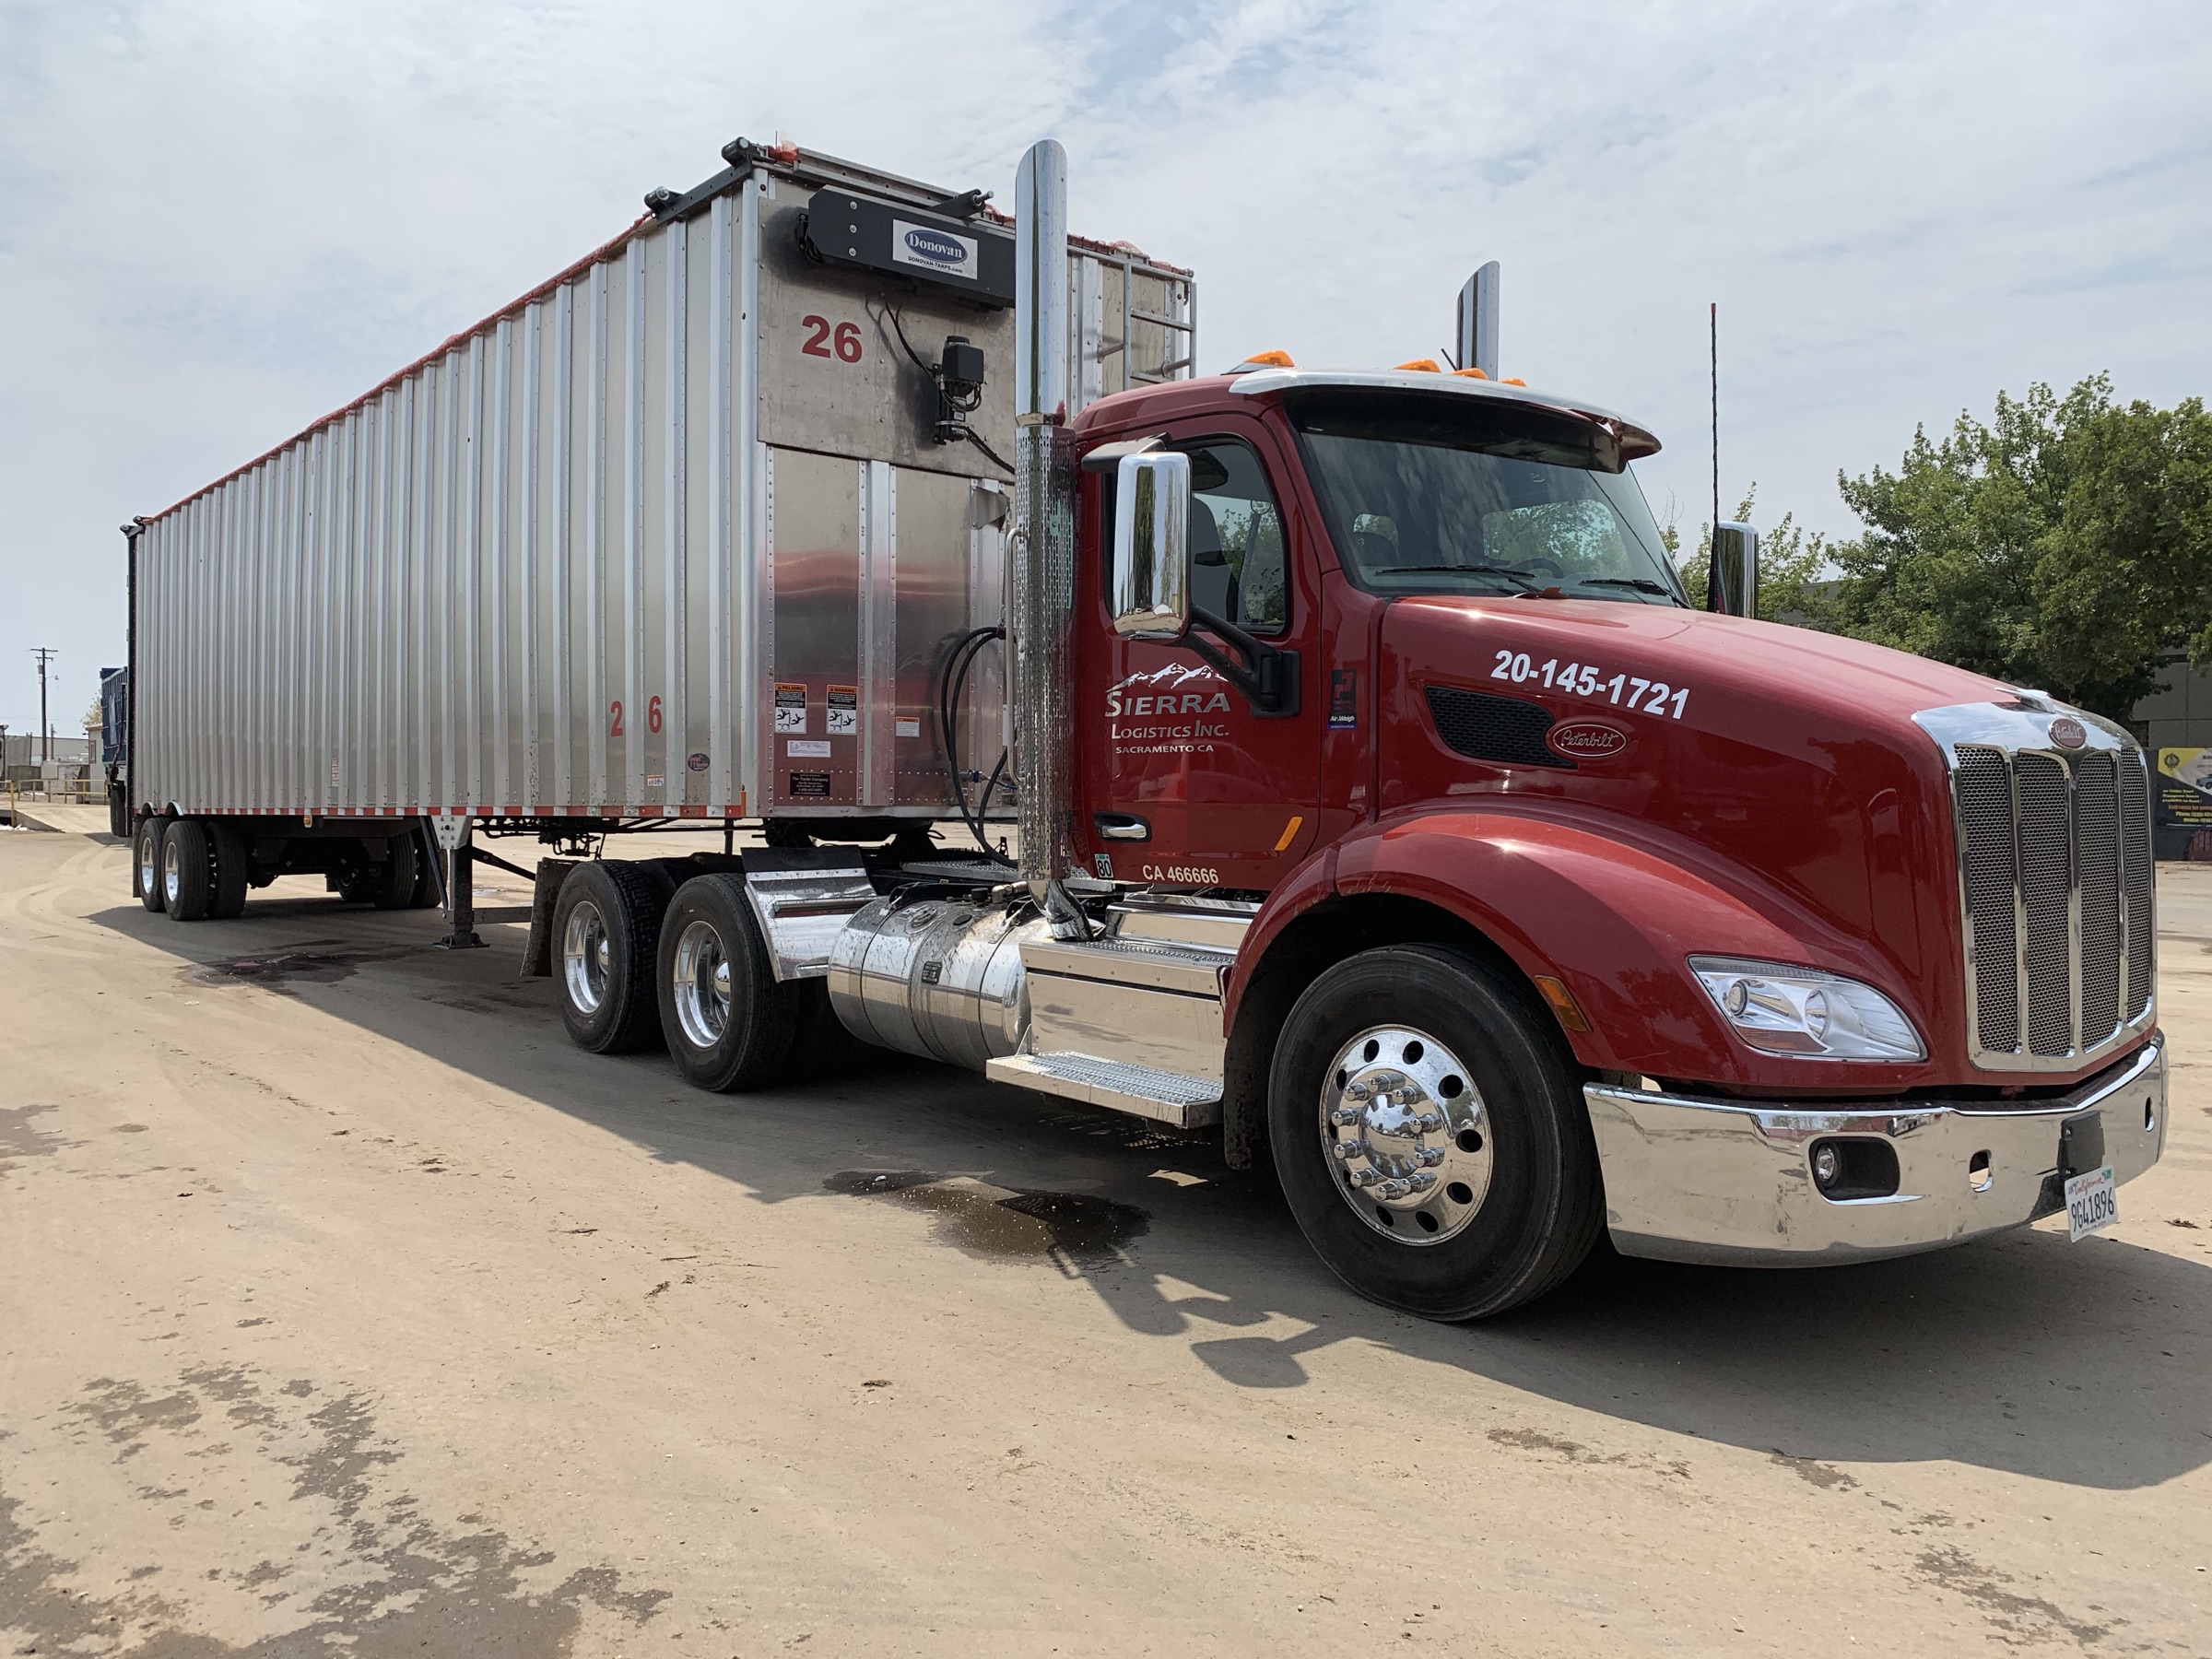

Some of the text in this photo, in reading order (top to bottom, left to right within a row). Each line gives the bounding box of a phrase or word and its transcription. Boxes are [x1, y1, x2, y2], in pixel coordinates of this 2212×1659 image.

[909, 233, 963, 258] Donovan
[908, 255, 963, 274] DONOVAN-TARPS.com
[801, 314, 863, 363] 26
[1490, 650, 1690, 720] 20-145-1721
[1105, 690, 1231, 717] SIERRA
[1561, 729, 1619, 747] Peterbilt
[2054, 723, 2082, 740] Peterbilt
[1115, 745, 1215, 754] SACRAMENTO CA
[1098, 859, 1112, 877] 80
[1143, 865, 1219, 884] CA 466666
[2075, 1177, 2104, 1195] California
[2071, 1187, 2115, 1232] 9G41896
